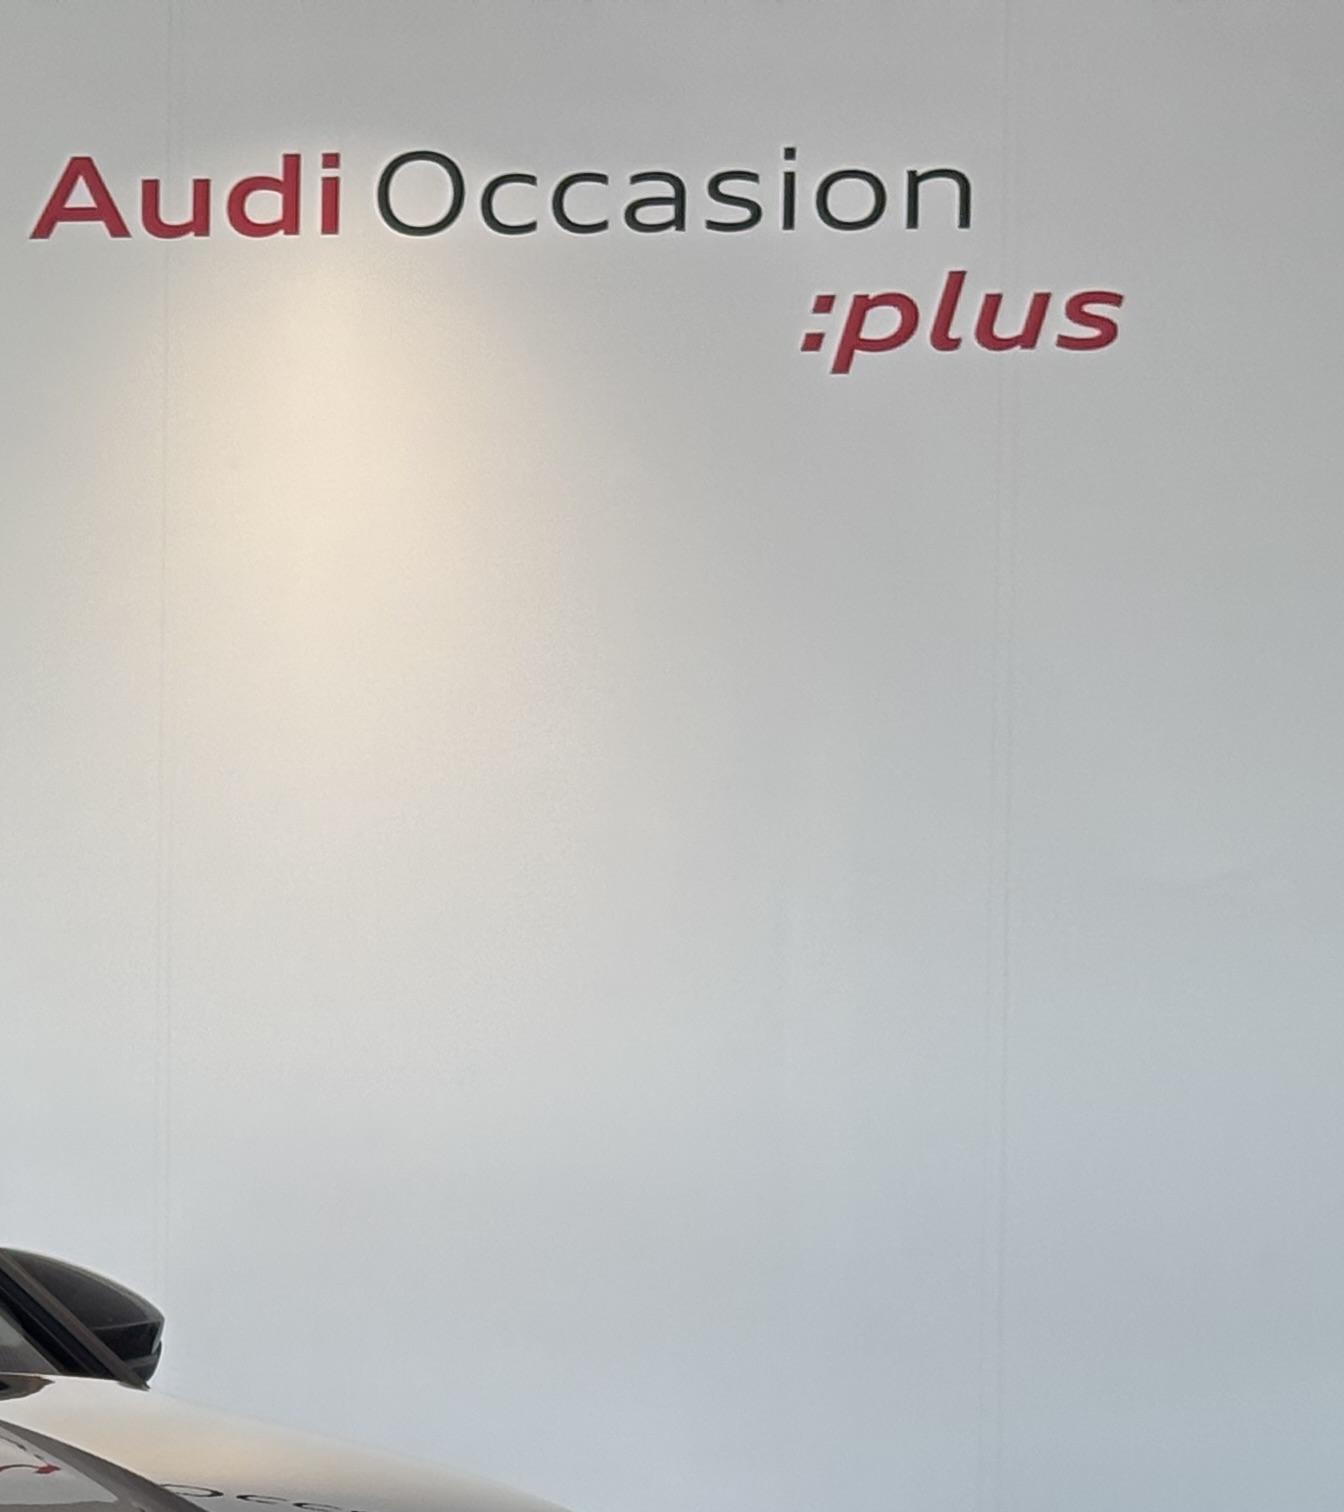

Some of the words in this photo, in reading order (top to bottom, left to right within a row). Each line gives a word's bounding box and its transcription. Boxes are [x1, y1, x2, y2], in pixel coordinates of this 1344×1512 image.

[29, 152, 342, 240] Audi
[375, 146, 973, 238] Occasion
[800, 269, 1125, 374] :plus
